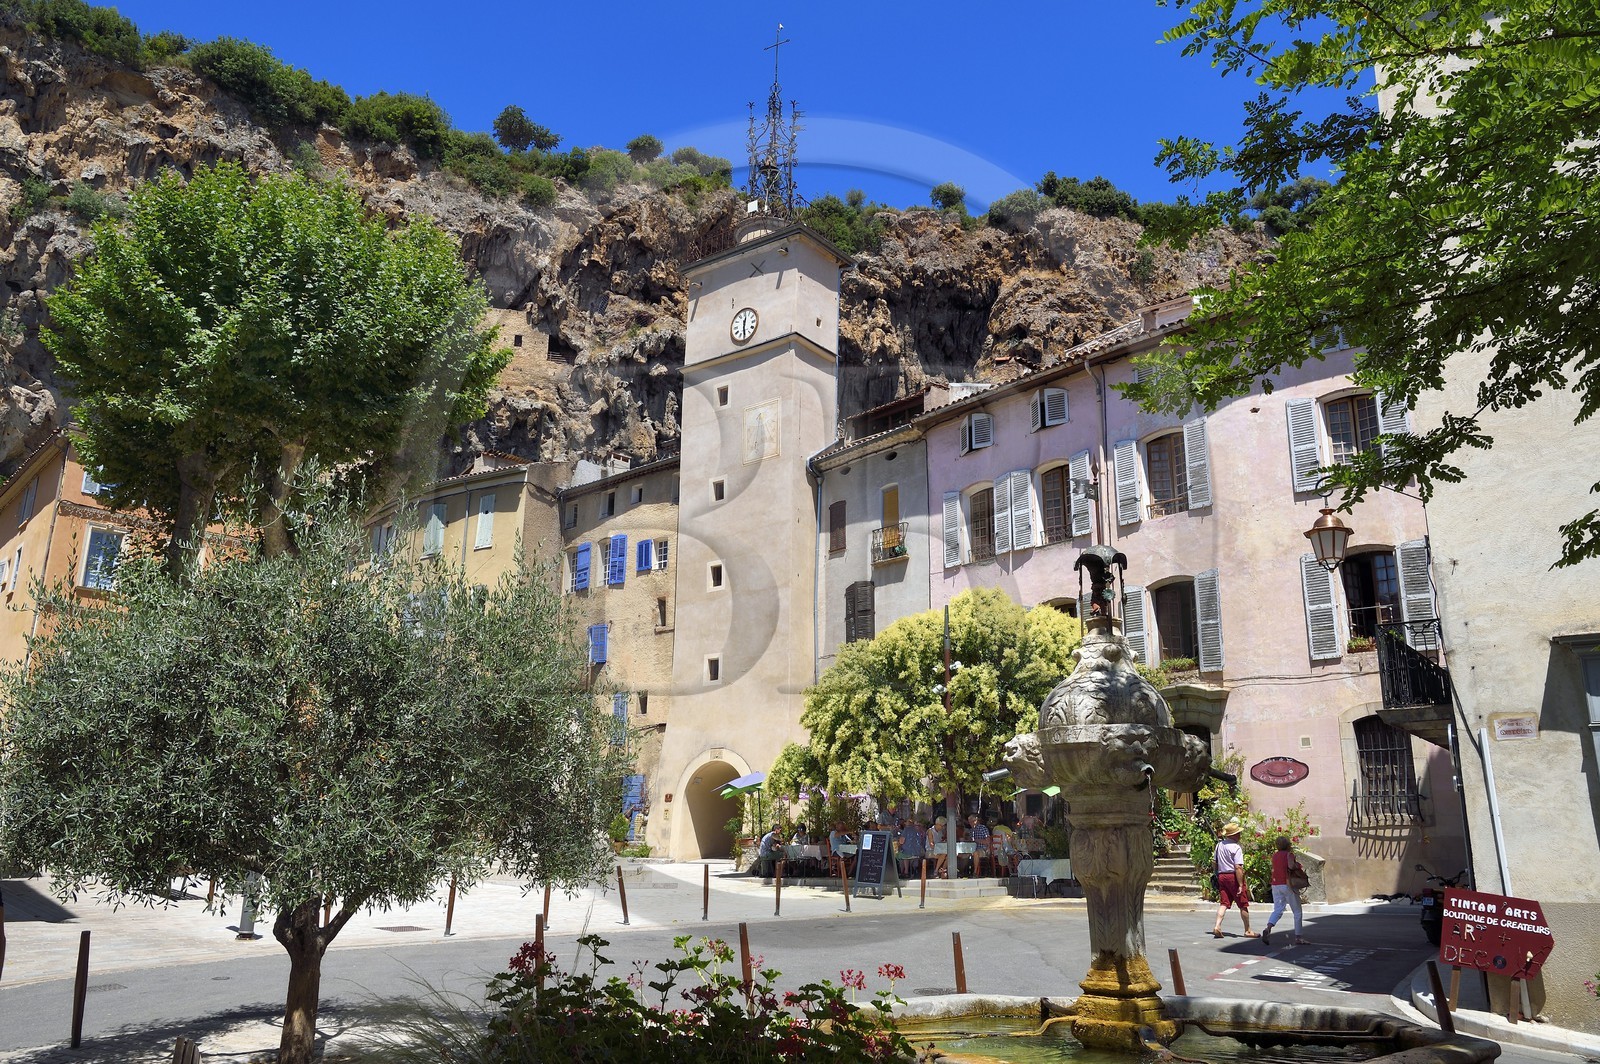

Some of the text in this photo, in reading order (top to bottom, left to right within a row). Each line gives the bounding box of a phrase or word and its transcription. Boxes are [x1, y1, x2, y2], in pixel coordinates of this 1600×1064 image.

[1450, 898, 1497, 913] TINTAM
[1505, 906, 1537, 921] ARTS
[1443, 909, 1551, 935] BOUTIQUE DE CREATEURS
